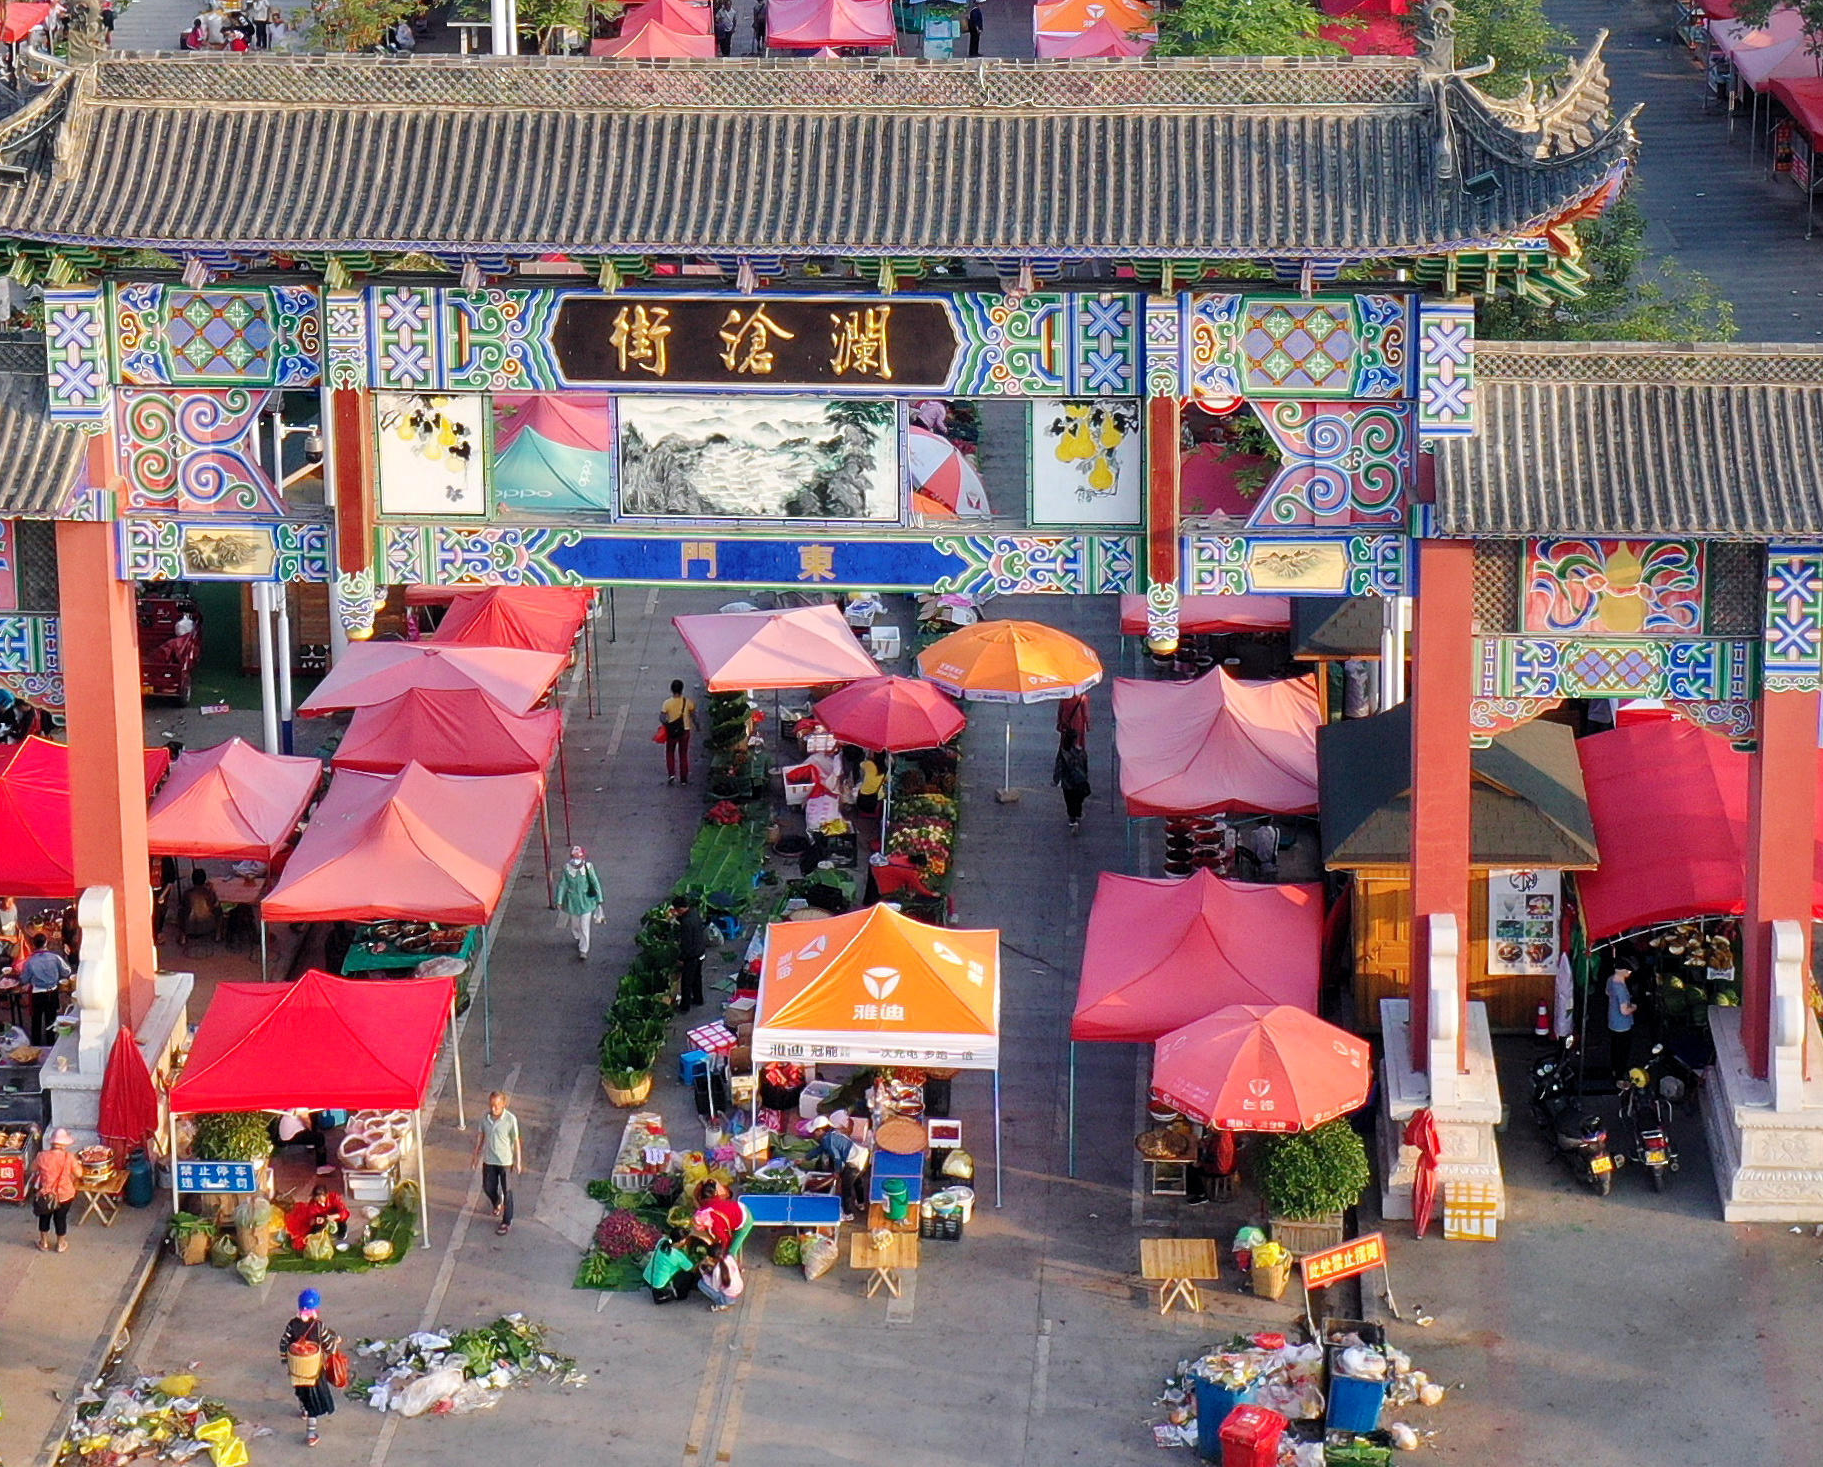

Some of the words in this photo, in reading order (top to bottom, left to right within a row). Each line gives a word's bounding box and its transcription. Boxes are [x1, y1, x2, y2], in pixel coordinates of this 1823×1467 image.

[852, 1004, 906, 1021] 雅迪
[180, 1165, 248, 1177] 禁止停车
